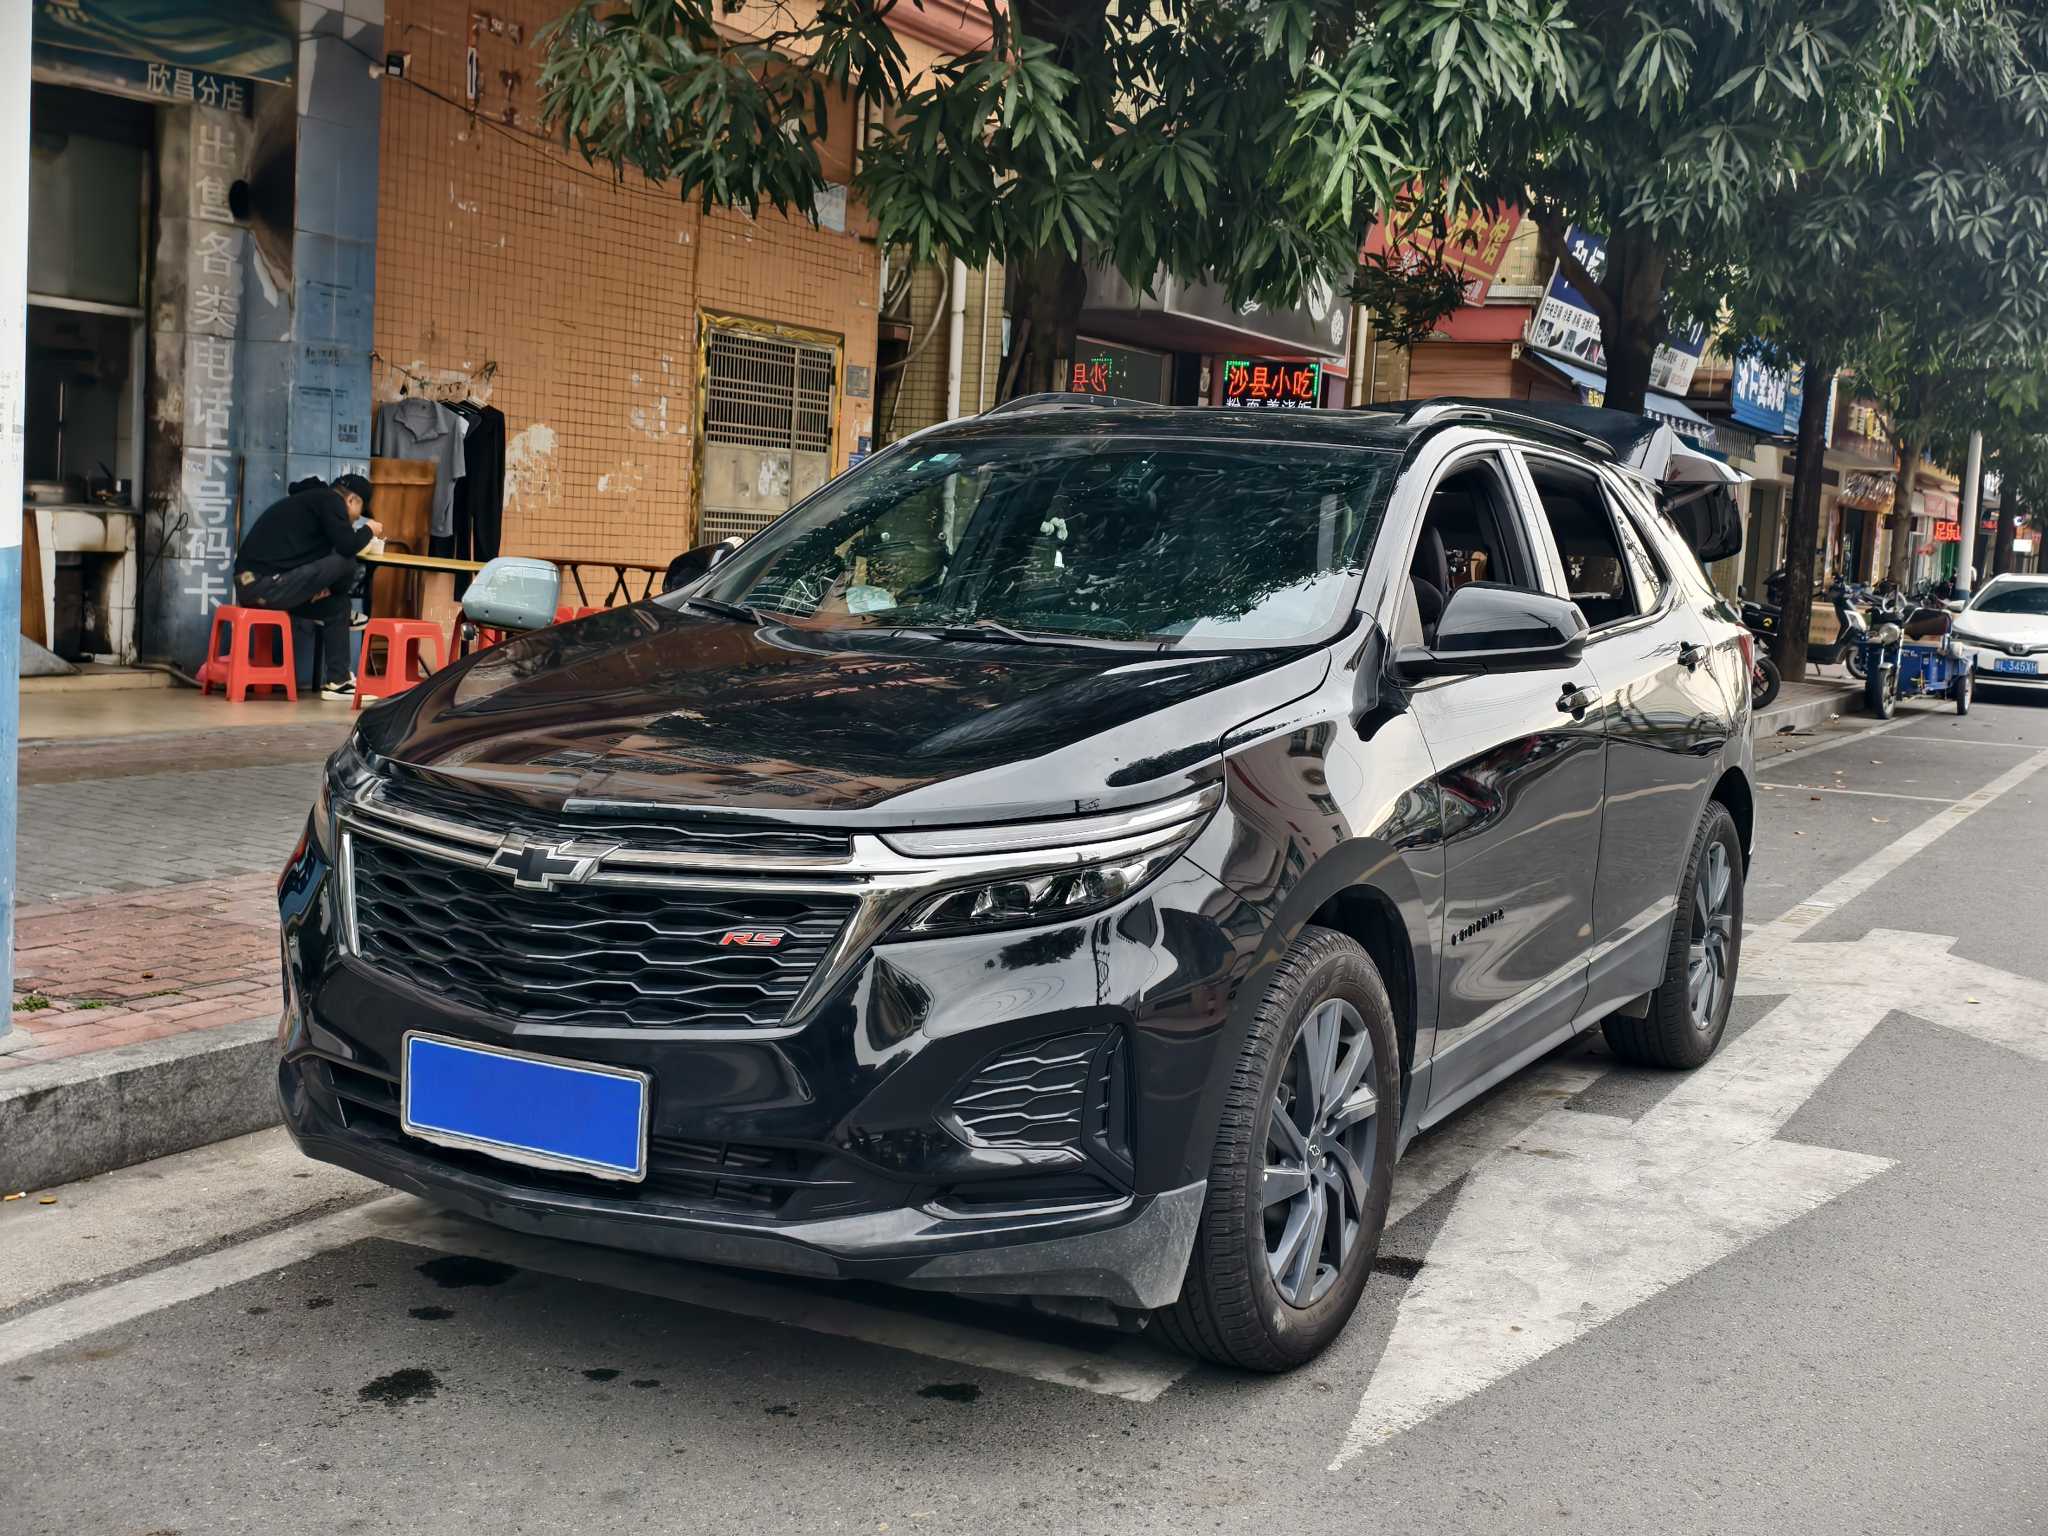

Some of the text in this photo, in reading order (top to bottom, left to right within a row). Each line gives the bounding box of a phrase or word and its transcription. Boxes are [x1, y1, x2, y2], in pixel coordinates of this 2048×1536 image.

[146, 63, 243, 111] 欣昌分店
[1228, 365, 1314, 398] 沙县小吃
[719, 931, 785, 947] RS
